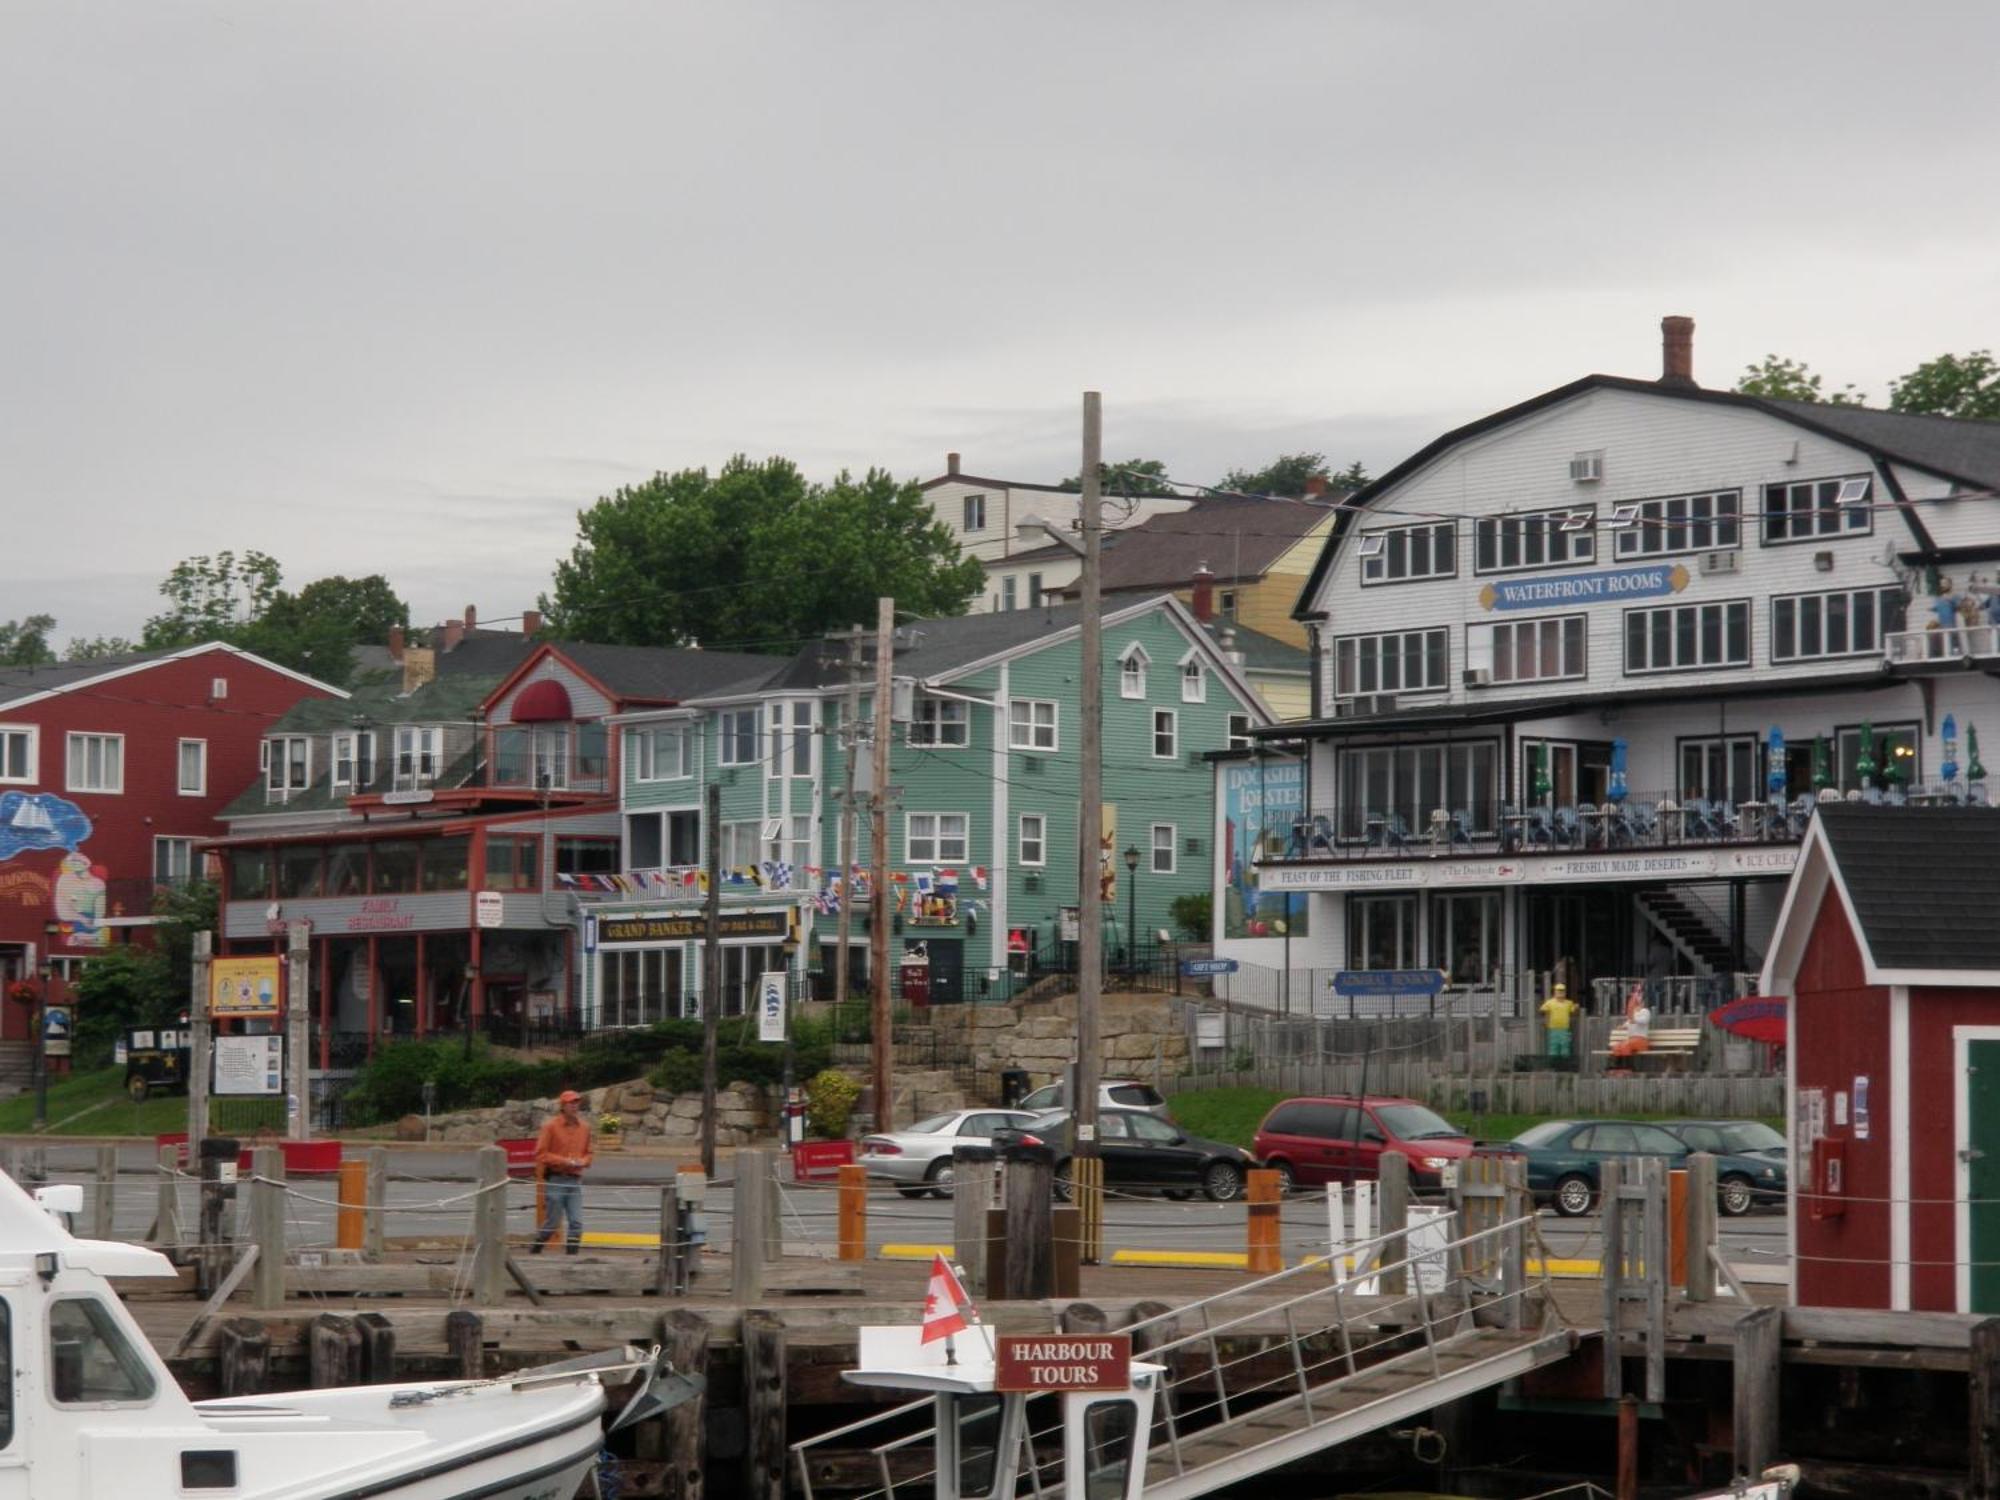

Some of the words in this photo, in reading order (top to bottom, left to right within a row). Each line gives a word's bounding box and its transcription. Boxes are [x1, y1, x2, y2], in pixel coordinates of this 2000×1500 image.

[1503, 577, 1604, 602] WATERFRONT
[1607, 571, 1663, 594] ROOMS
[1566, 859, 1608, 874] FRESHLY
[1611, 858, 1641, 873] MADE
[1643, 856, 1688, 871] DESERTS
[1746, 854, 1763, 867] ICE
[1766, 852, 1798, 866] CREA
[1281, 871, 1308, 884] FEAST
[1309, 870, 1322, 883] OF
[1323, 870, 1342, 882] THE
[1345, 868, 1382, 882] FISHING
[1384, 867, 1414, 881] FLEET
[607, 922, 646, 938] GRAND
[649, 920, 694, 936] BANKER
[1012, 1342, 1115, 1361] HARBOUR
[1030, 1365, 1099, 1384] TOURS
